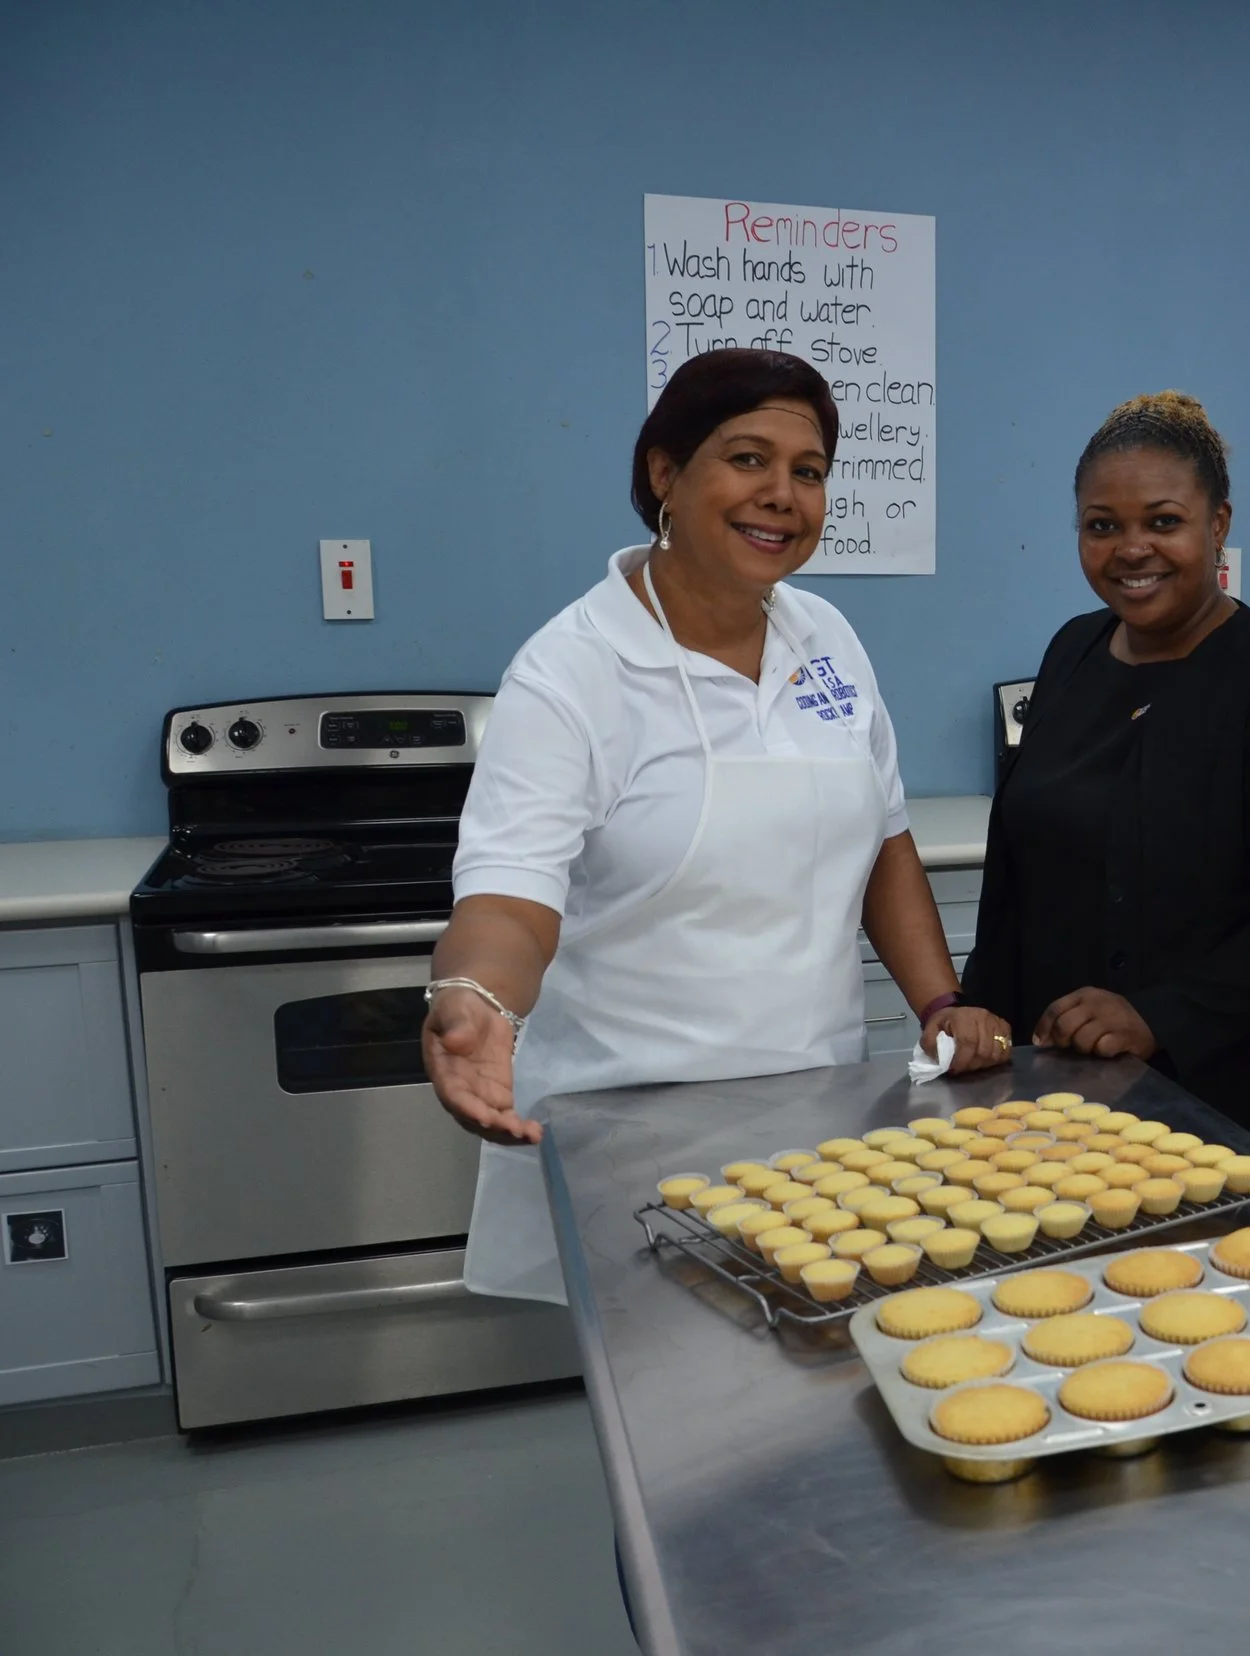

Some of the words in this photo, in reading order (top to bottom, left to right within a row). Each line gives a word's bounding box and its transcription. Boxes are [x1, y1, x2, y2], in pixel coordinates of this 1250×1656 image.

[725, 202, 898, 253] Reminders
[663, 239, 731, 281] Wash
[742, 247, 806, 284] hands
[823, 255, 874, 290] with
[669, 290, 734, 328] soap
[745, 289, 788, 322] and
[800, 295, 875, 329] water.
[839, 411, 928, 447] wellery.
[886, 500, 917, 519] or
